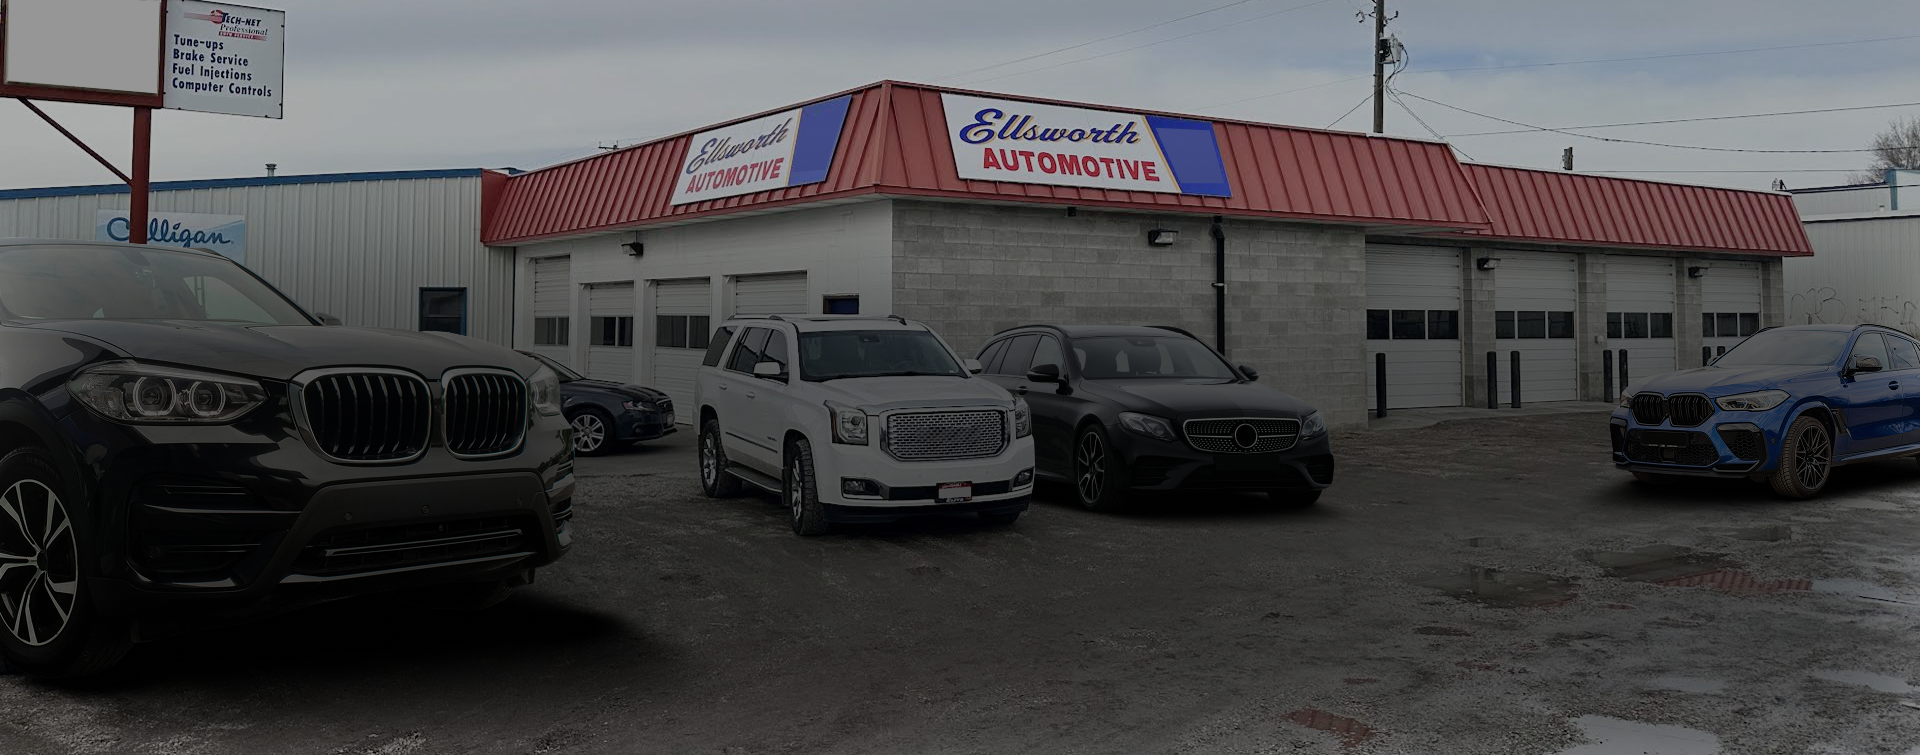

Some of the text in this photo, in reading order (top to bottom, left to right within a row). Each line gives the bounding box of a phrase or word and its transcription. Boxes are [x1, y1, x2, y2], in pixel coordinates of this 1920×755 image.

[222, 12, 261, 26] TECH-NET
[220, 24, 268, 35] Professional
[173, 34, 224, 51] Tune-ups
[173, 48, 249, 67] Brake Service
[172, 63, 252, 81] Fuel Injections
[172, 77, 272, 97] Computer Controls
[959, 108, 1140, 144] Ellsworth
[685, 117, 792, 175] Ellsworth
[983, 147, 1160, 182] AUTOMOTIVE
[685, 157, 785, 194] AUTOMOTIVE
[106, 216, 231, 248] Clligan
